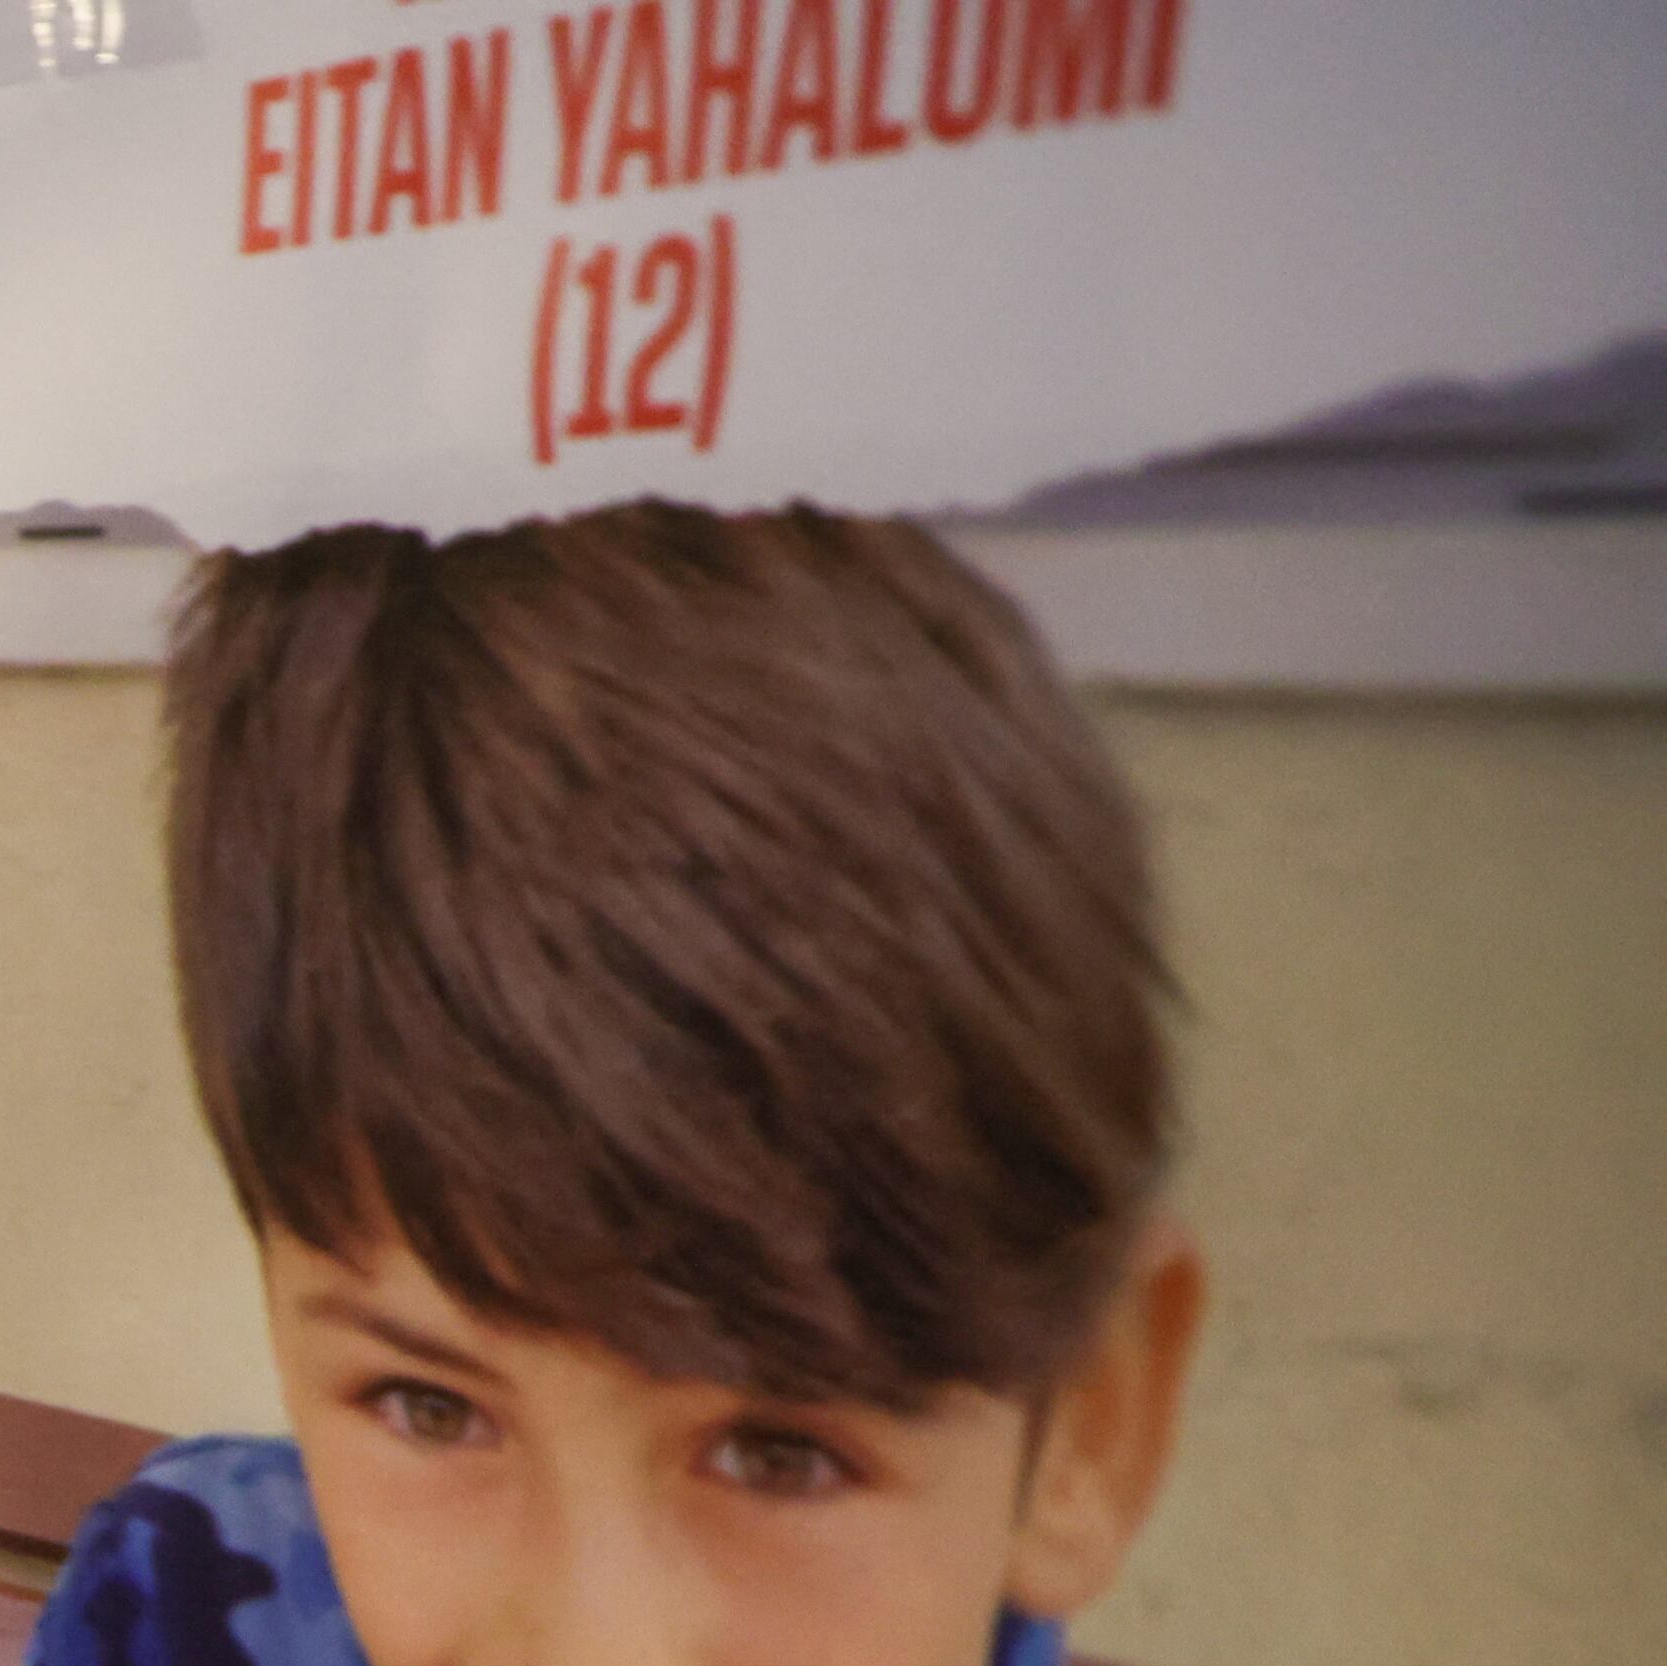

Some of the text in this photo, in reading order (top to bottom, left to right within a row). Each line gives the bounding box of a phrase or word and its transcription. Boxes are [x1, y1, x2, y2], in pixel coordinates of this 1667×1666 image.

[239, 0, 1185, 256] EITAN YAHALOMI
[530, 213, 736, 463] (12)
